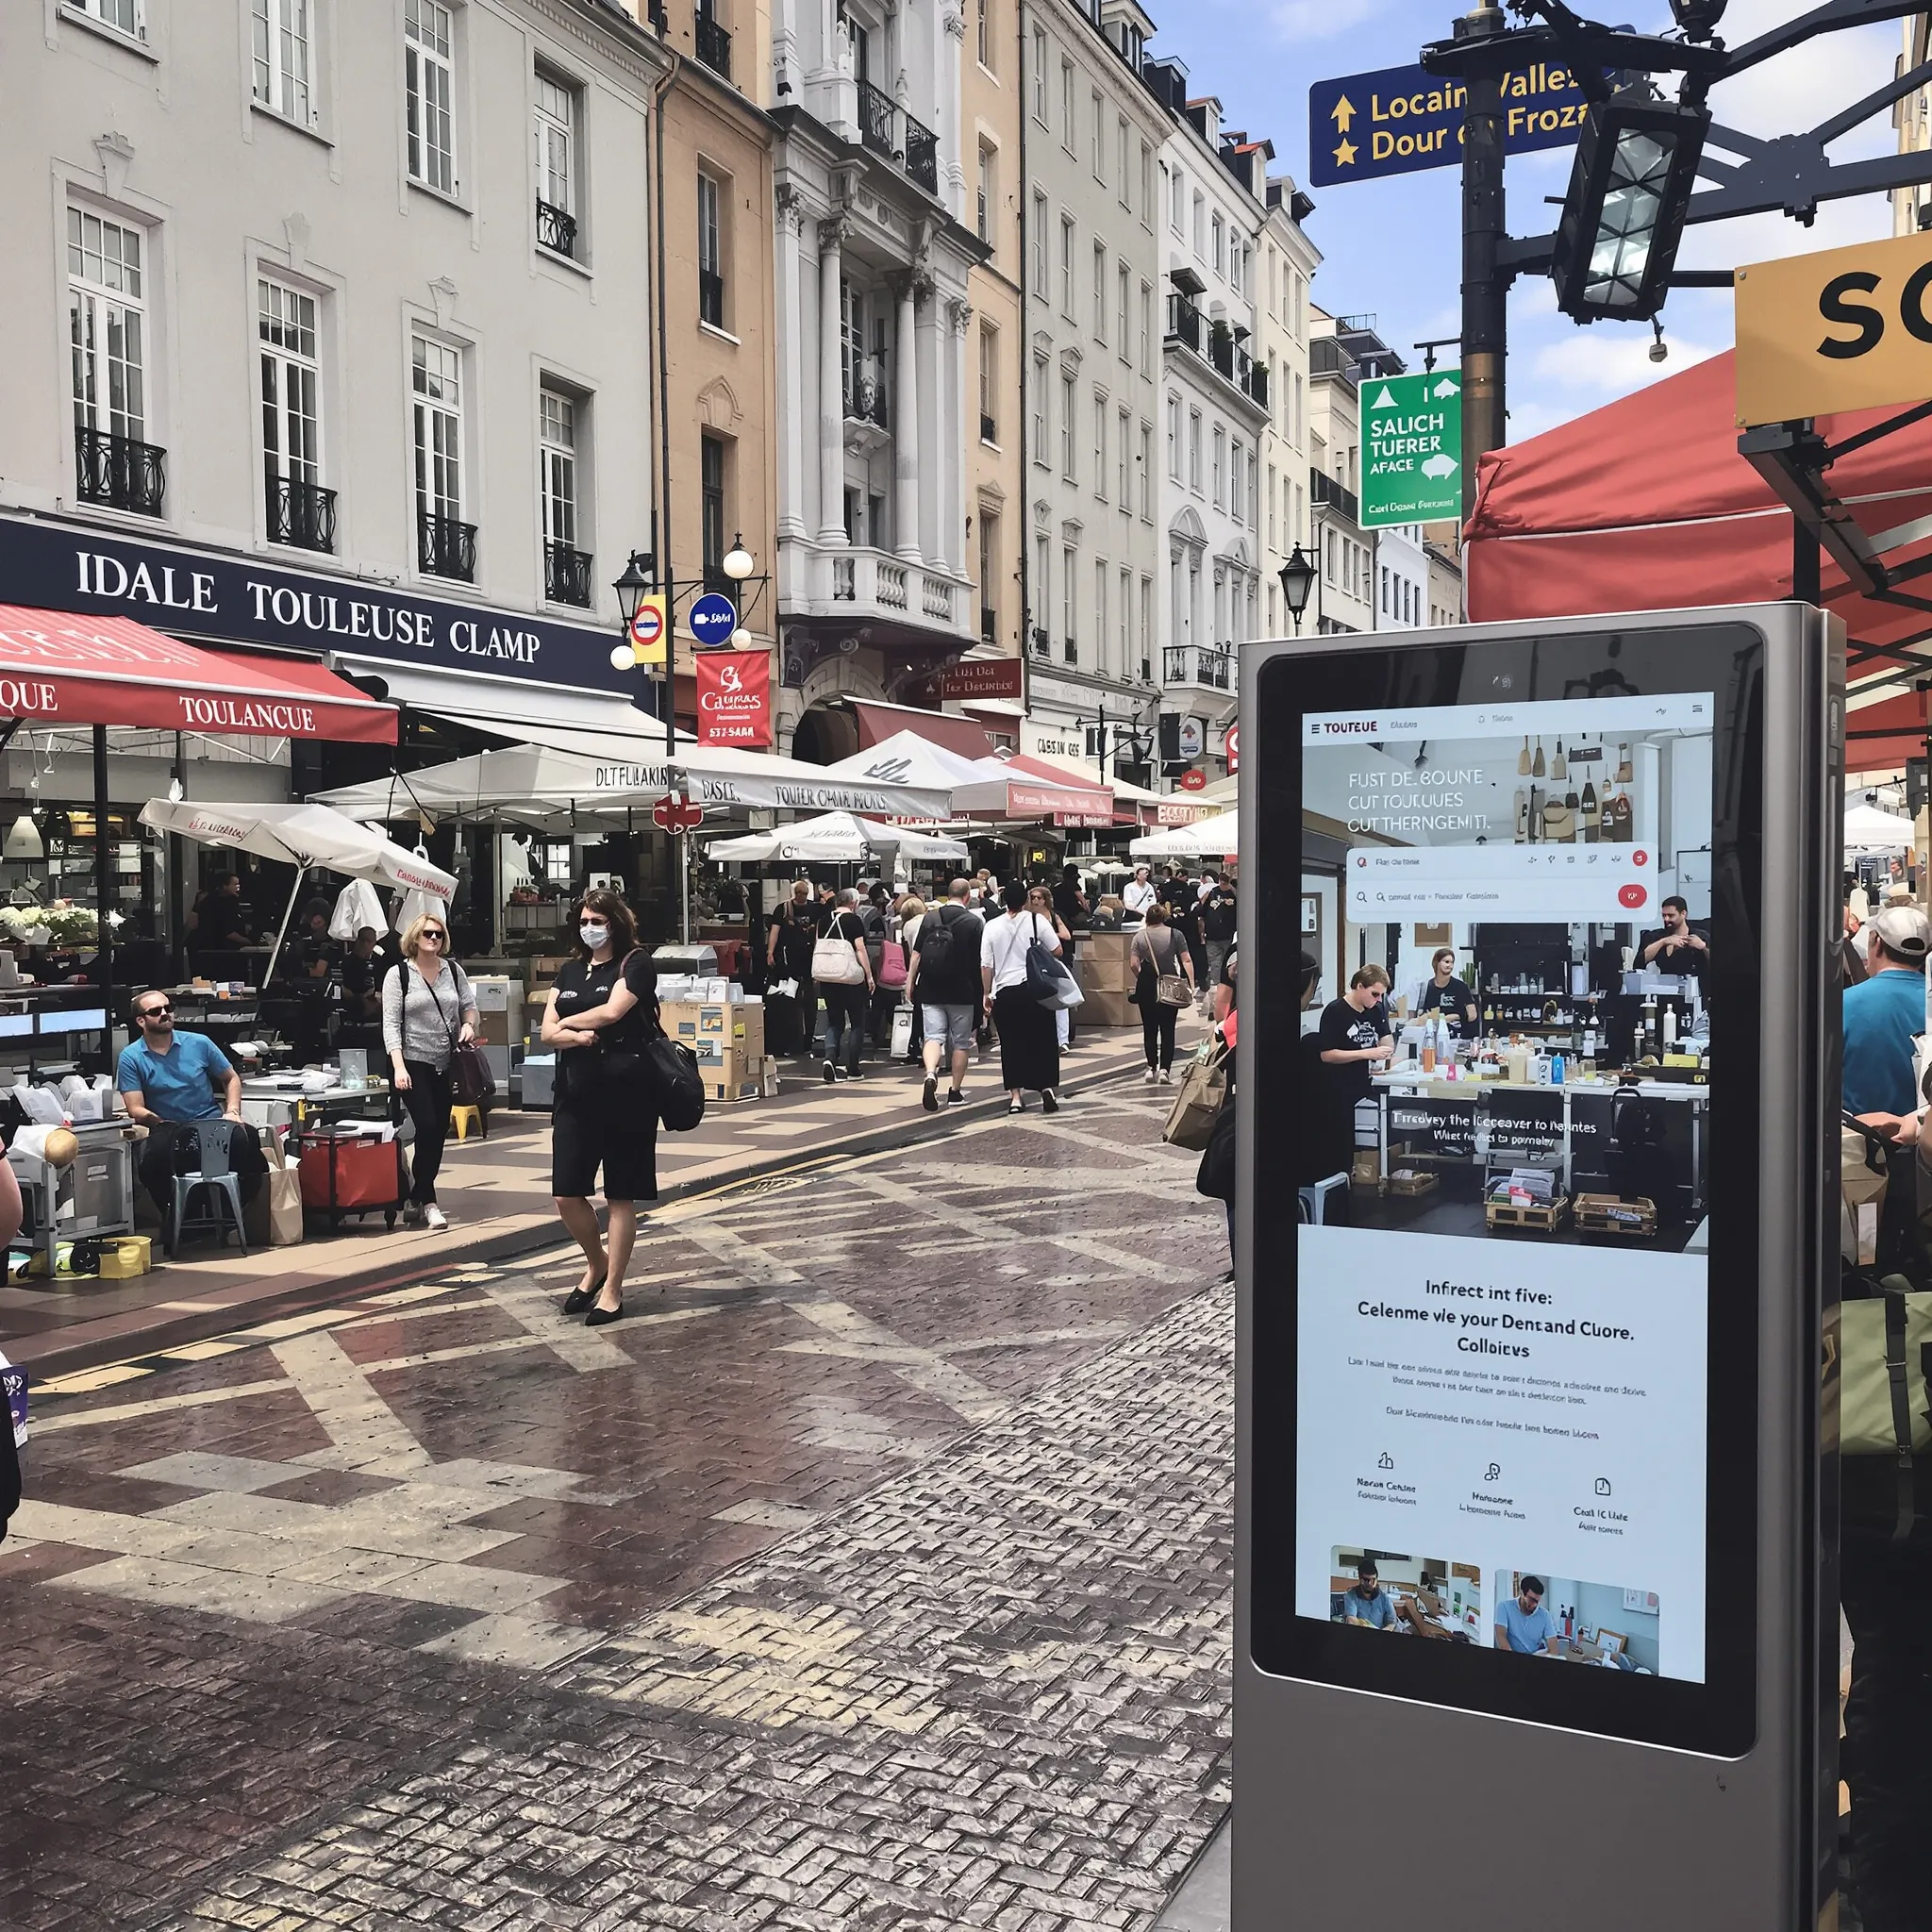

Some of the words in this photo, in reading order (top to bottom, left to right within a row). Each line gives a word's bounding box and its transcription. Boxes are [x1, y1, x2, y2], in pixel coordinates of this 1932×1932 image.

[1373, 127, 1448, 160] Dour
[1371, 412, 1444, 438] SALICH
[1370, 435, 1442, 458] TUERER
[1370, 458, 1415, 475] AFACE
[76, 551, 219, 613] IDALE
[246, 580, 435, 648] TOULEUSE
[448, 621, 541, 664] CLAMP
[179, 695, 317, 732] TOULANCUE
[1349, 772, 1386, 788] FUST
[1450, 1113, 1470, 1126] the
[1425, 1279, 1484, 1299] Infrect
[1489, 1285, 1510, 1301] int
[1515, 1289, 1553, 1305] five:
[1357, 1301, 1429, 1322] Celenme
[1460, 1312, 1499, 1328] your
